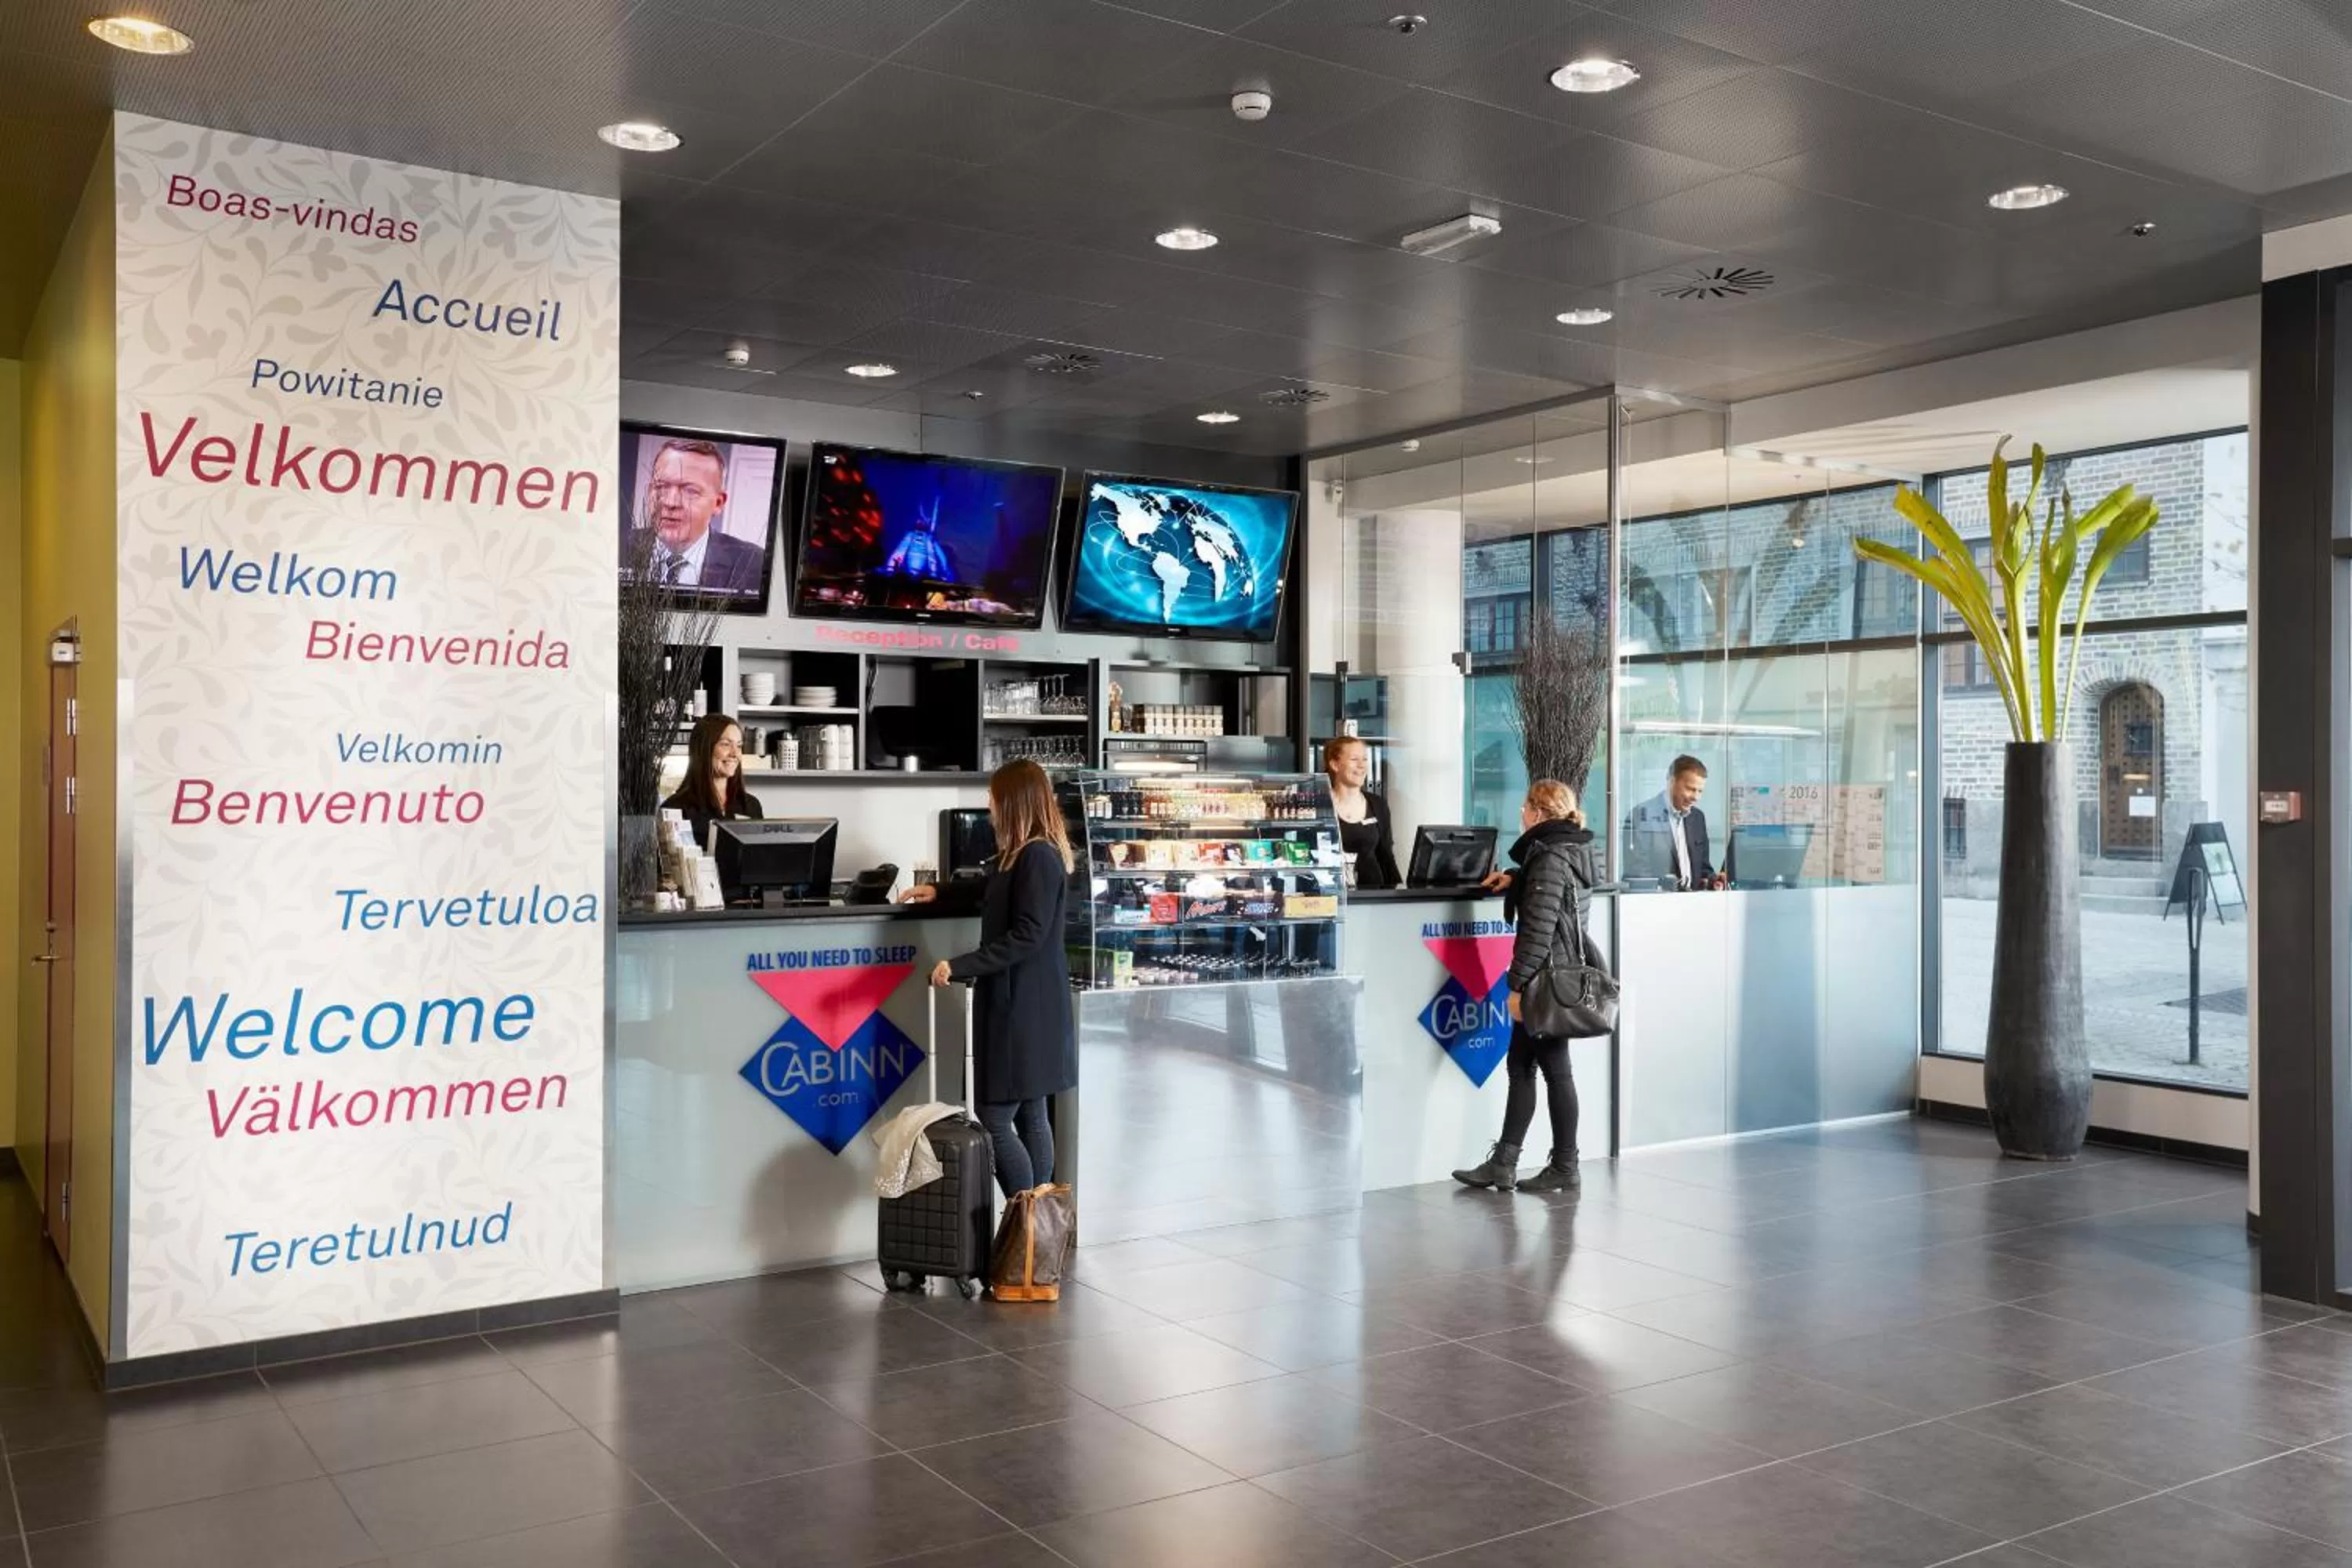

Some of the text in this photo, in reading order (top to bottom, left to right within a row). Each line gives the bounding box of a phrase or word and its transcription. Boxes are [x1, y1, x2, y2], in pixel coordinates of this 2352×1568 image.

[166, 173, 419, 244] Boas-vindas
[372, 278, 561, 341] Accueil
[251, 358, 444, 408] Powitanie
[140, 411, 600, 514] Velkommen
[180, 546, 397, 601] Welkom
[305, 620, 571, 669] Bienvenida
[336, 733, 503, 764] Velkomin
[171, 779, 485, 825] Benvenuto
[1789, 786, 1819, 799] 2016
[335, 884, 598, 931] Tervetuloa
[1421, 922, 1440, 937] ALL
[1442, 921, 1462, 936] YOU
[1464, 920, 1489, 935] NEED
[1491, 920, 1503, 934] TO
[746, 946, 917, 971] ALL YOU NEED TO SLEEP
[143, 988, 535, 1066] Welcome
[761, 1041, 905, 1097] CABINN
[205, 1073, 568, 1138] Välkommen
[224, 1201, 513, 1277] Teretulnud
